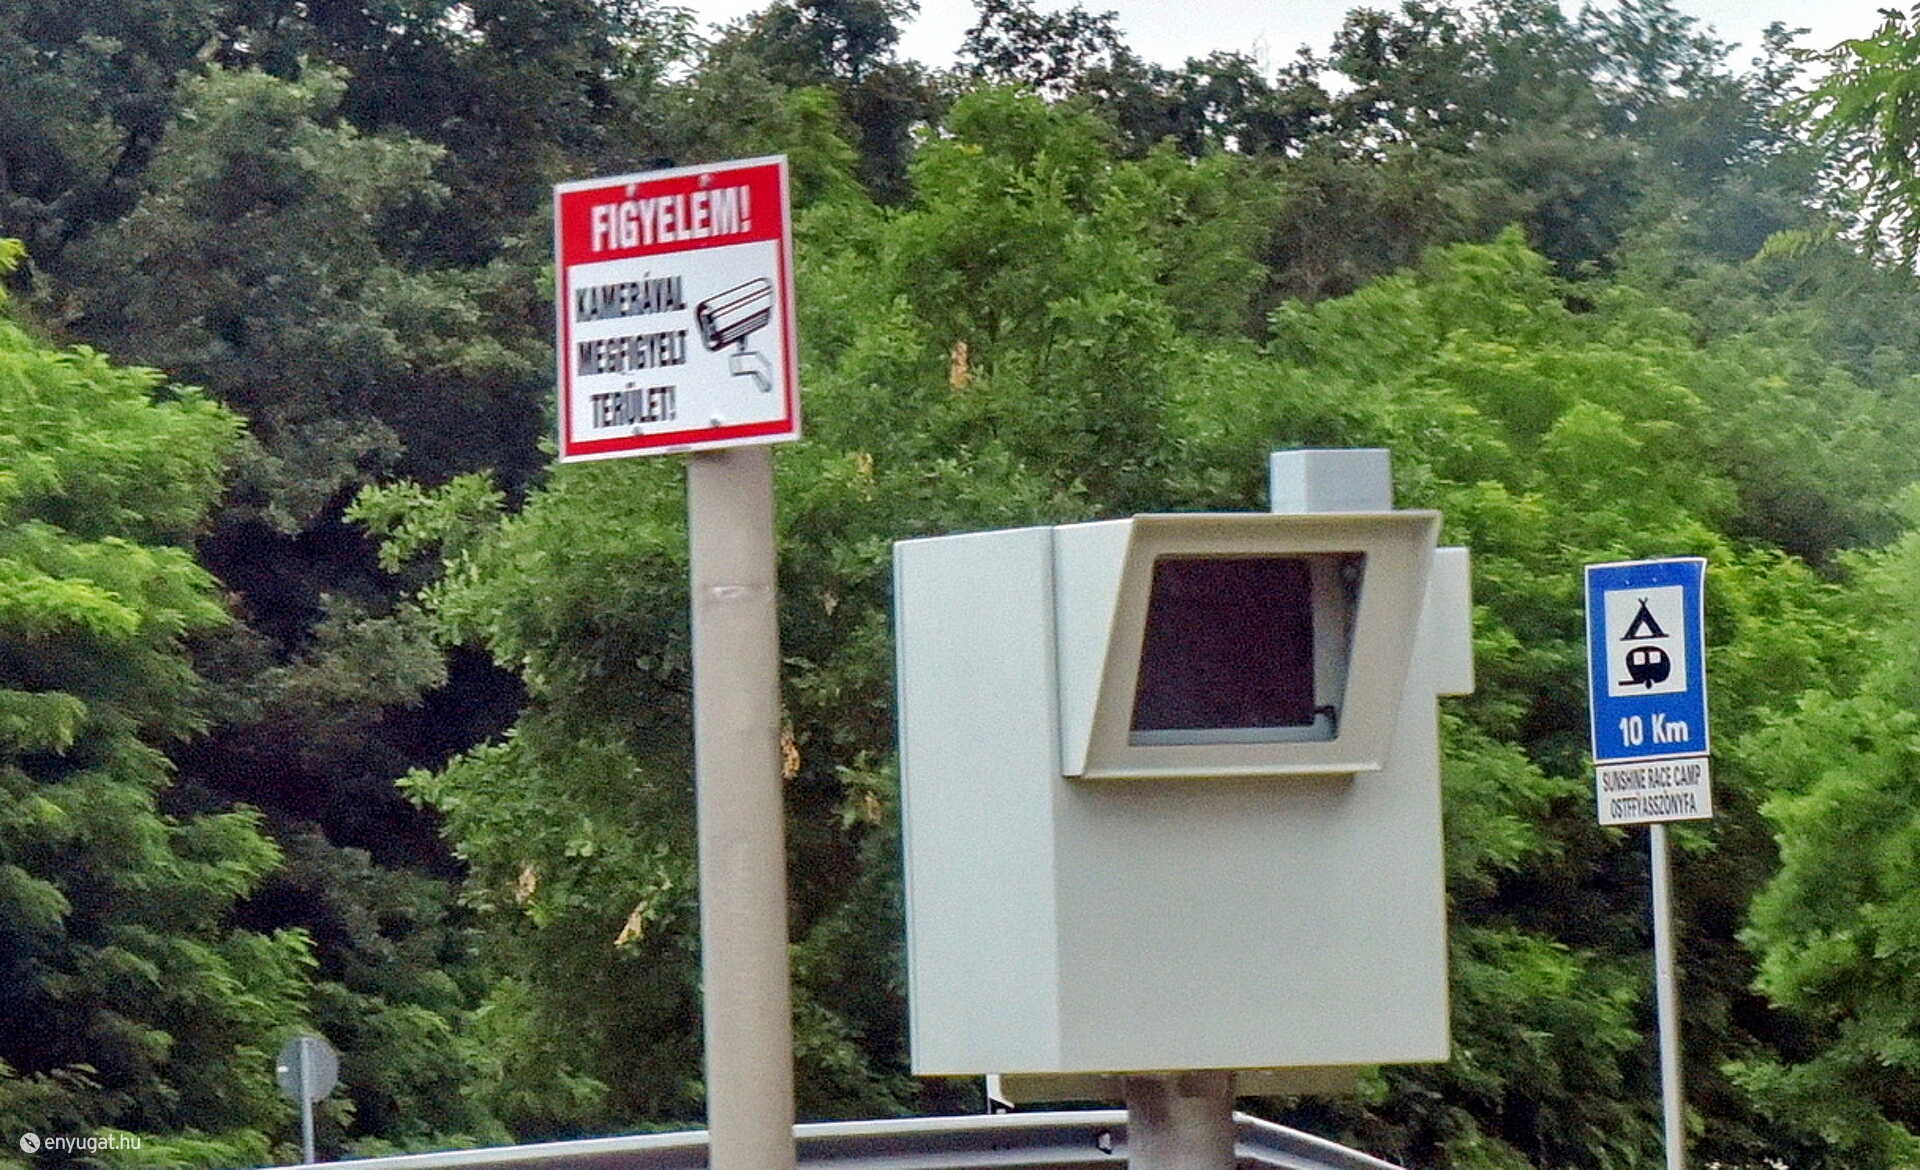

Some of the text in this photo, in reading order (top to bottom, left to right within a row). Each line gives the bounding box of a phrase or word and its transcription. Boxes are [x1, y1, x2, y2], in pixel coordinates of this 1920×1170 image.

[576, 271, 686, 323] KAMERÁVAL
[577, 329, 688, 376] MEGFIGYELT
[590, 381, 677, 428] TERÜLET!
[1619, 713, 1689, 747] 10 Km
[1602, 764, 1700, 792] SUNSHINE RACE CAMP
